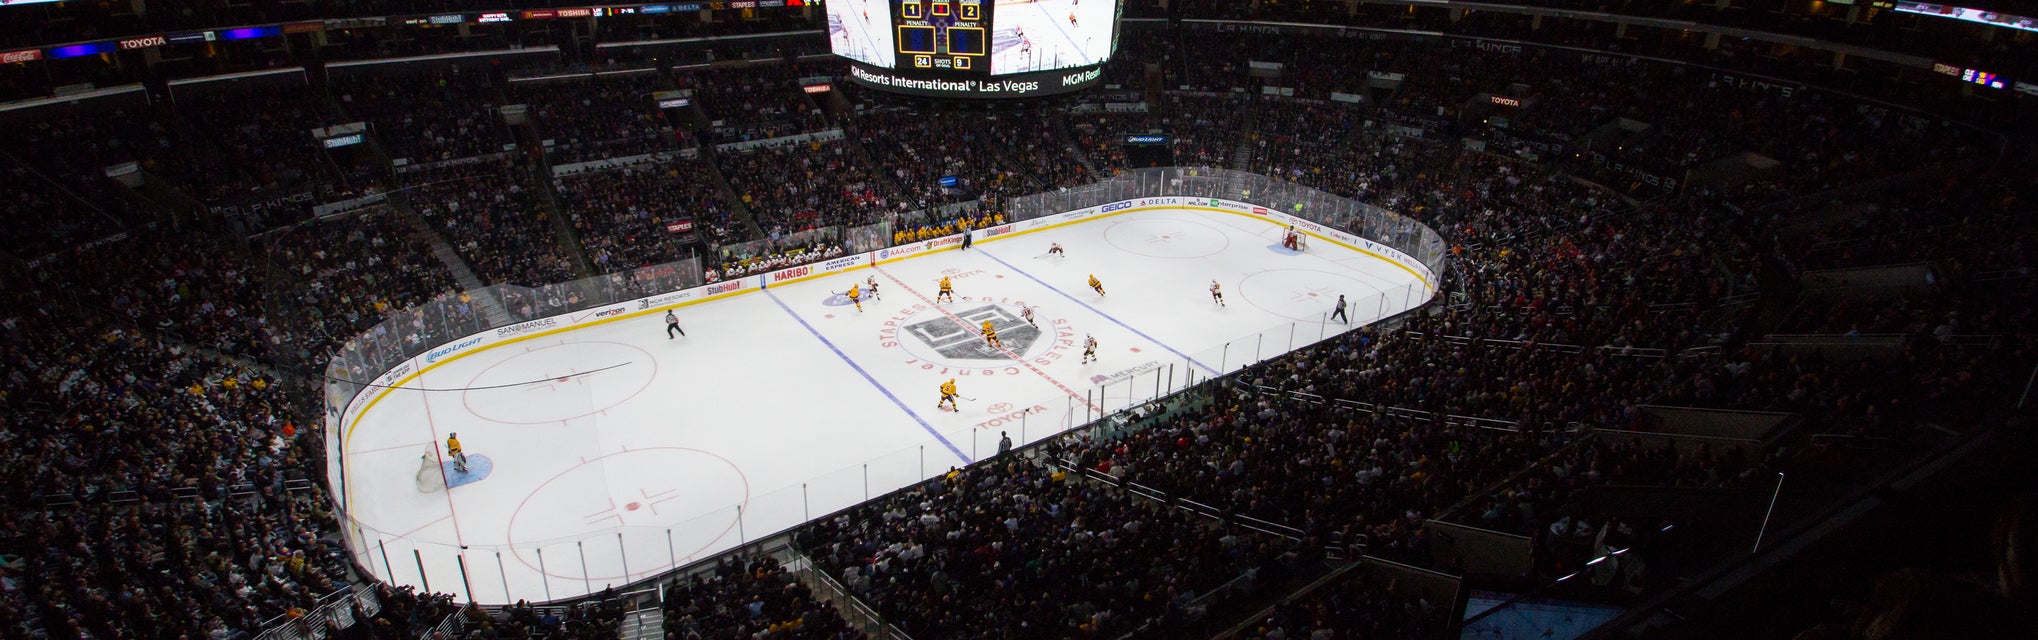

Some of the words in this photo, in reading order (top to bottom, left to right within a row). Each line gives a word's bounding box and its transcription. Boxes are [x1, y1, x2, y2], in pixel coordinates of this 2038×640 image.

[558, 9, 591, 17] TOSHIBA
[909, 5, 915, 15] 1
[967, 6, 974, 16] 2
[119, 36, 167, 50] TOYOTA
[917, 57, 928, 66] 24
[956, 59, 962, 67] 9
[860, 68, 890, 86] Resorts
[979, 81, 1001, 92] Las
[1003, 81, 1039, 93] Vegas
[1062, 72, 1084, 86] MGM
[803, 85, 831, 94] TOSHIBA
[1490, 96, 1519, 107] TOYOTA
[1101, 201, 1132, 213] GEICO
[1148, 198, 1177, 206] DELTA
[667, 222, 693, 231] STAPLES
[986, 225, 1011, 237] StubHub!
[1298, 220, 1322, 233] TOYOTA
[933, 234, 963, 248] DraftKings
[890, 244, 921, 257] AAA.com
[825, 255, 861, 267] AMERICAN
[825, 261, 856, 271] EXPRESS
[774, 267, 808, 282] HARIBO
[707, 281, 740, 296] StubHub!
[595, 307, 626, 317] verizon
[497, 325, 515, 336] SAN
[521, 318, 558, 330] MANUEL
[879, 302, 926, 348] STAPLES
[452, 337, 484, 352] LIGHT
[1109, 360, 1160, 380] MERCURY
[976, 404, 1048, 431] TOYOTA
